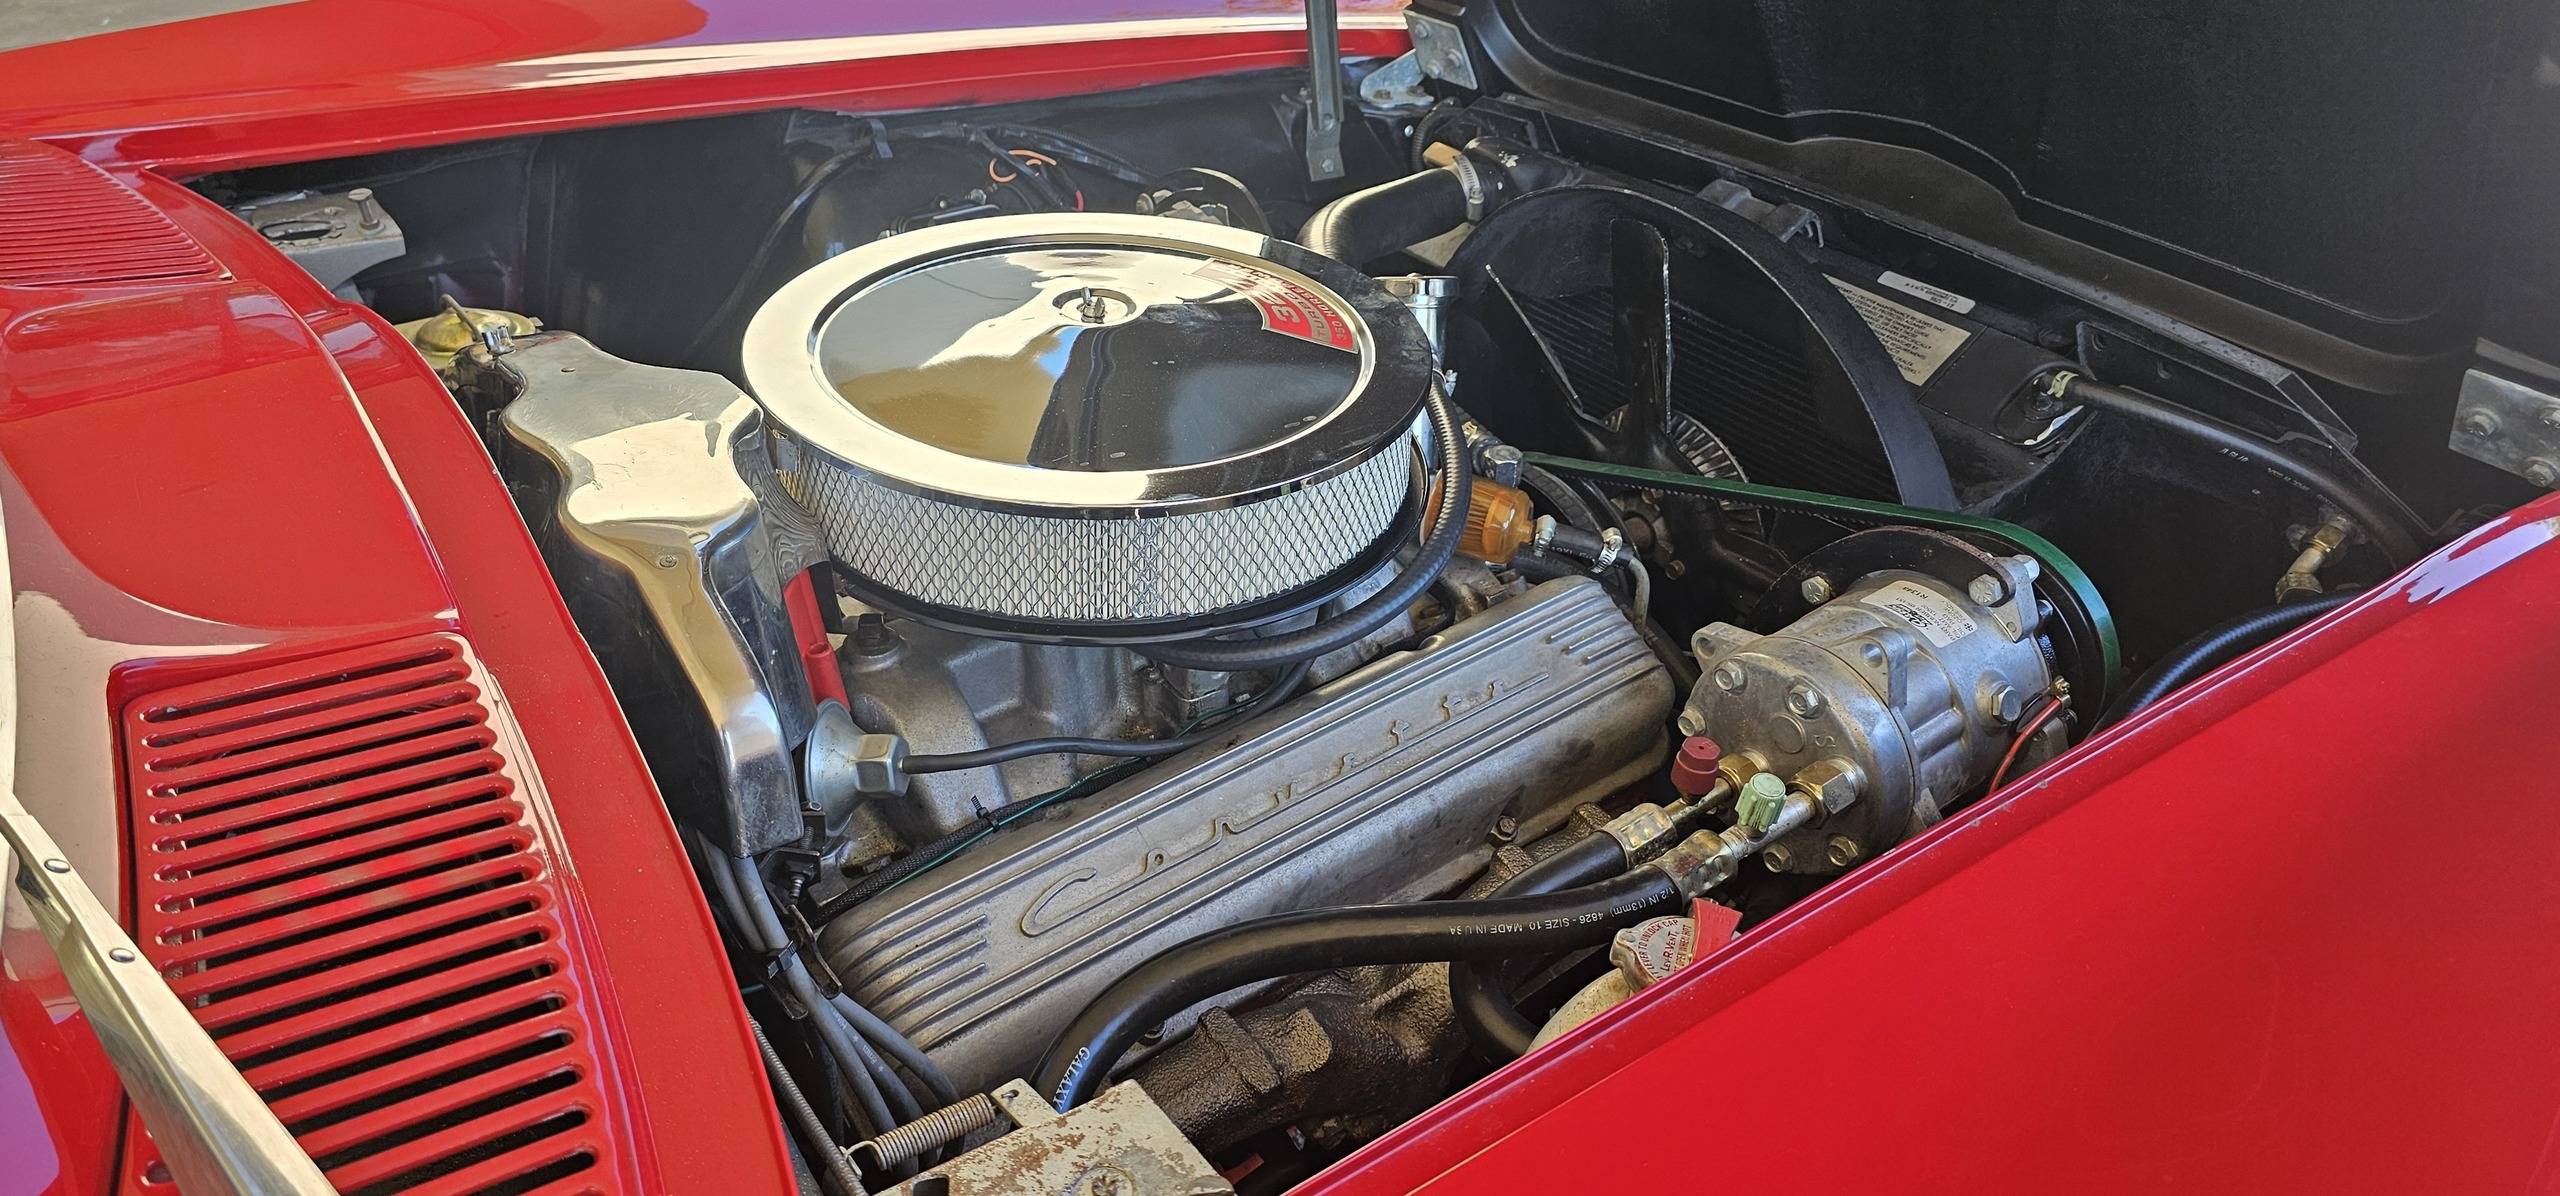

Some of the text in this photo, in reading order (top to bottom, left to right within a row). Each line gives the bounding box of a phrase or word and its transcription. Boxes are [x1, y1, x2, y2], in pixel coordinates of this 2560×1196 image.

[1649, 894, 1659, 904] IN
[1610, 898, 1646, 917] (13mm)
[1545, 917, 1570, 930] SIZE
[1580, 912, 1604, 924] 4826
[1662, 919, 1678, 928] CAP
[1476, 924, 1487, 934] IN
[1490, 923, 1523, 934] MADE
[1529, 920, 1542, 931] 10
[1640, 922, 1663, 941] UNLOCK
[1638, 941, 1647, 950] TO
[1053, 1047, 1090, 1111] GALAXY
